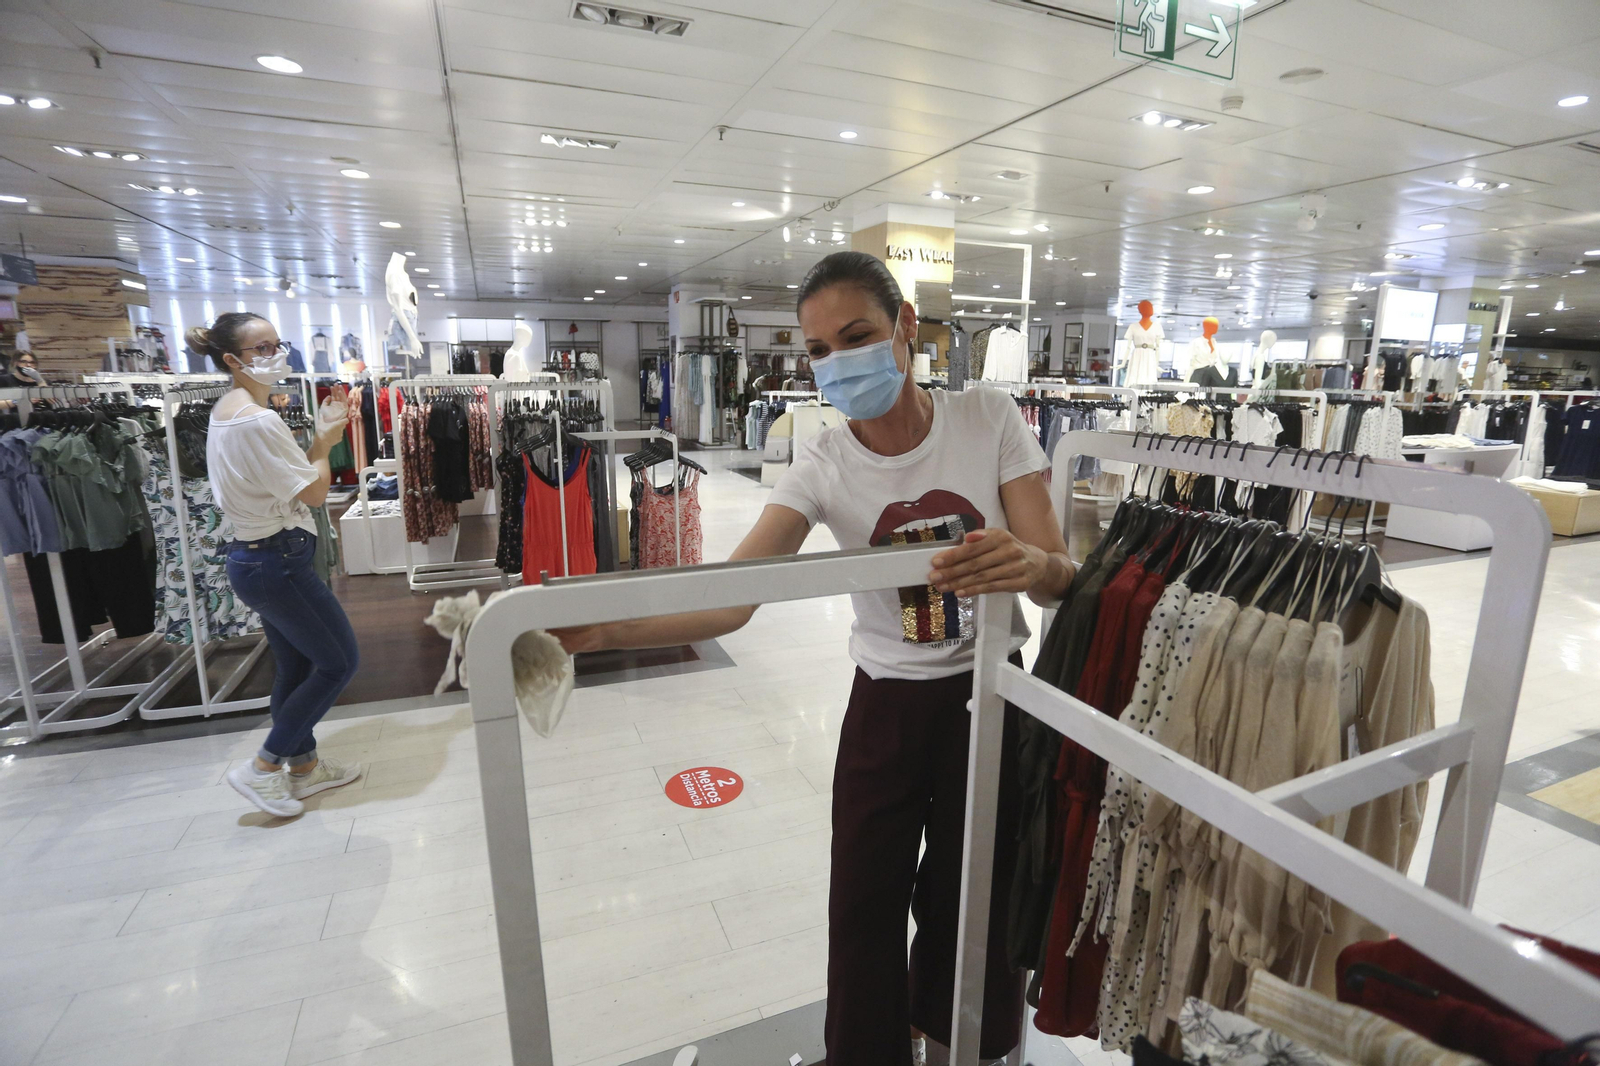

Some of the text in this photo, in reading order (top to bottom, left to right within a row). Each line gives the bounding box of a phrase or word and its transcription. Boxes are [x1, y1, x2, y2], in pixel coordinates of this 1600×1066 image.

[887, 244, 914, 261] EASY
[680, 773, 702, 806] Distancia
[695, 770, 721, 803] Metros
[717, 777, 736, 787] 2
